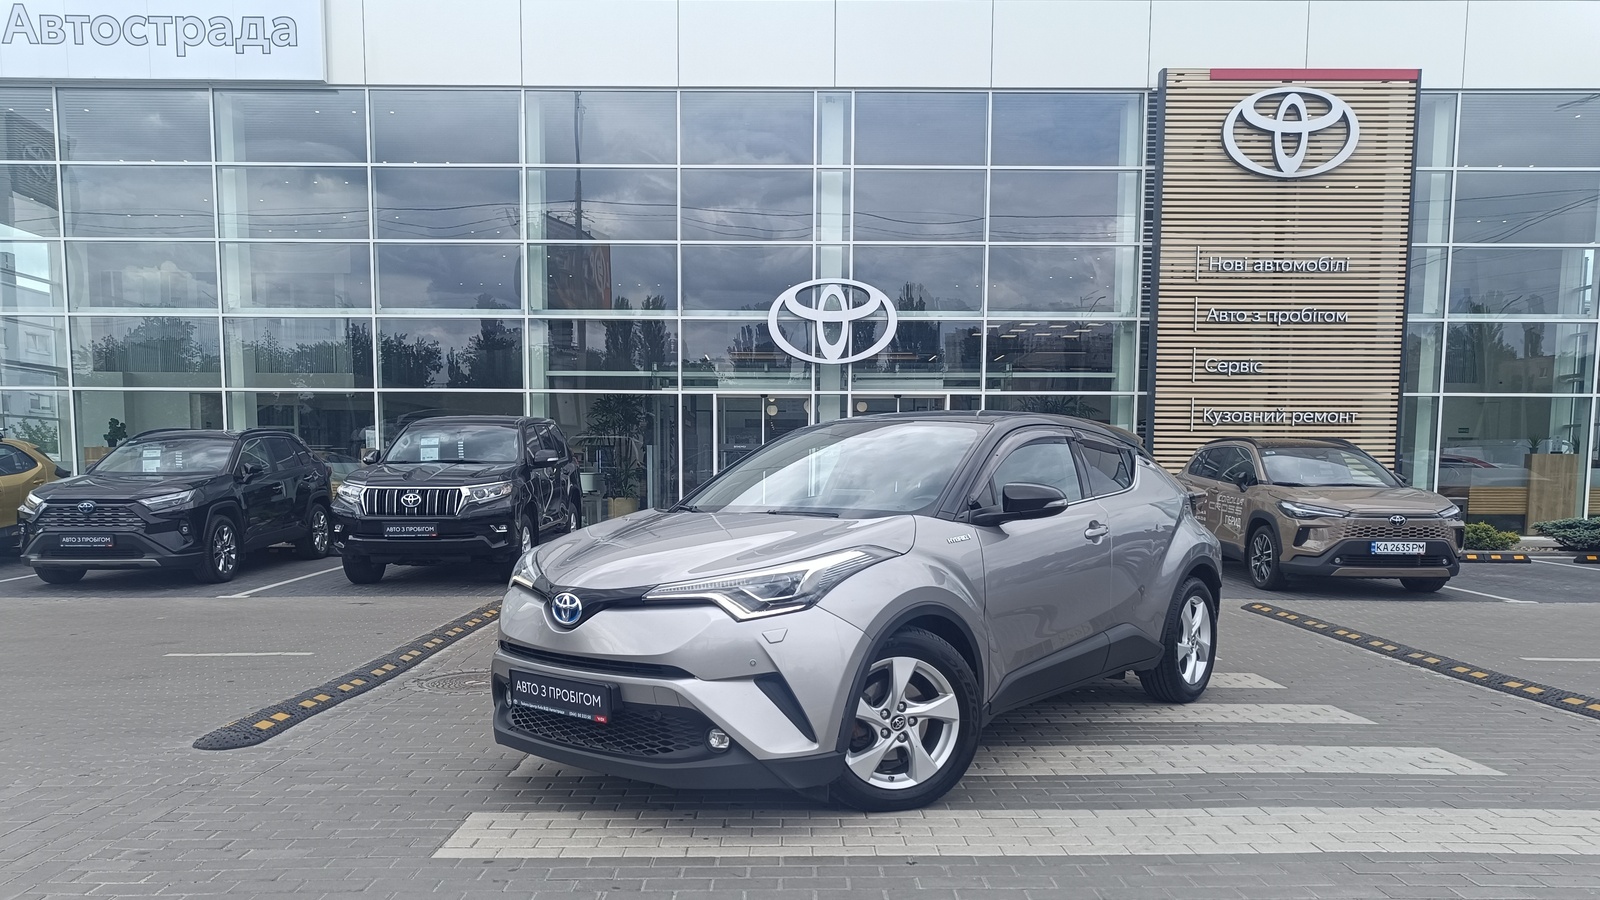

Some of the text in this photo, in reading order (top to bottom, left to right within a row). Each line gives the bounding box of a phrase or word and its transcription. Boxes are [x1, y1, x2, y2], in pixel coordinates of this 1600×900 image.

[2, 3, 298, 57] Автострада
[1209, 256, 1350, 272] Нові автомобілі
[1206, 307, 1348, 326] Авто з пробігом
[1204, 358, 1263, 376] Сервіс
[1202, 408, 1359, 426] Кузовний ремонт
[1209, 501, 1243, 515] CROSS
[1390, 543, 1410, 551] 2635
[516, 680, 601, 707] АВТО З ПРОБІГОМ
